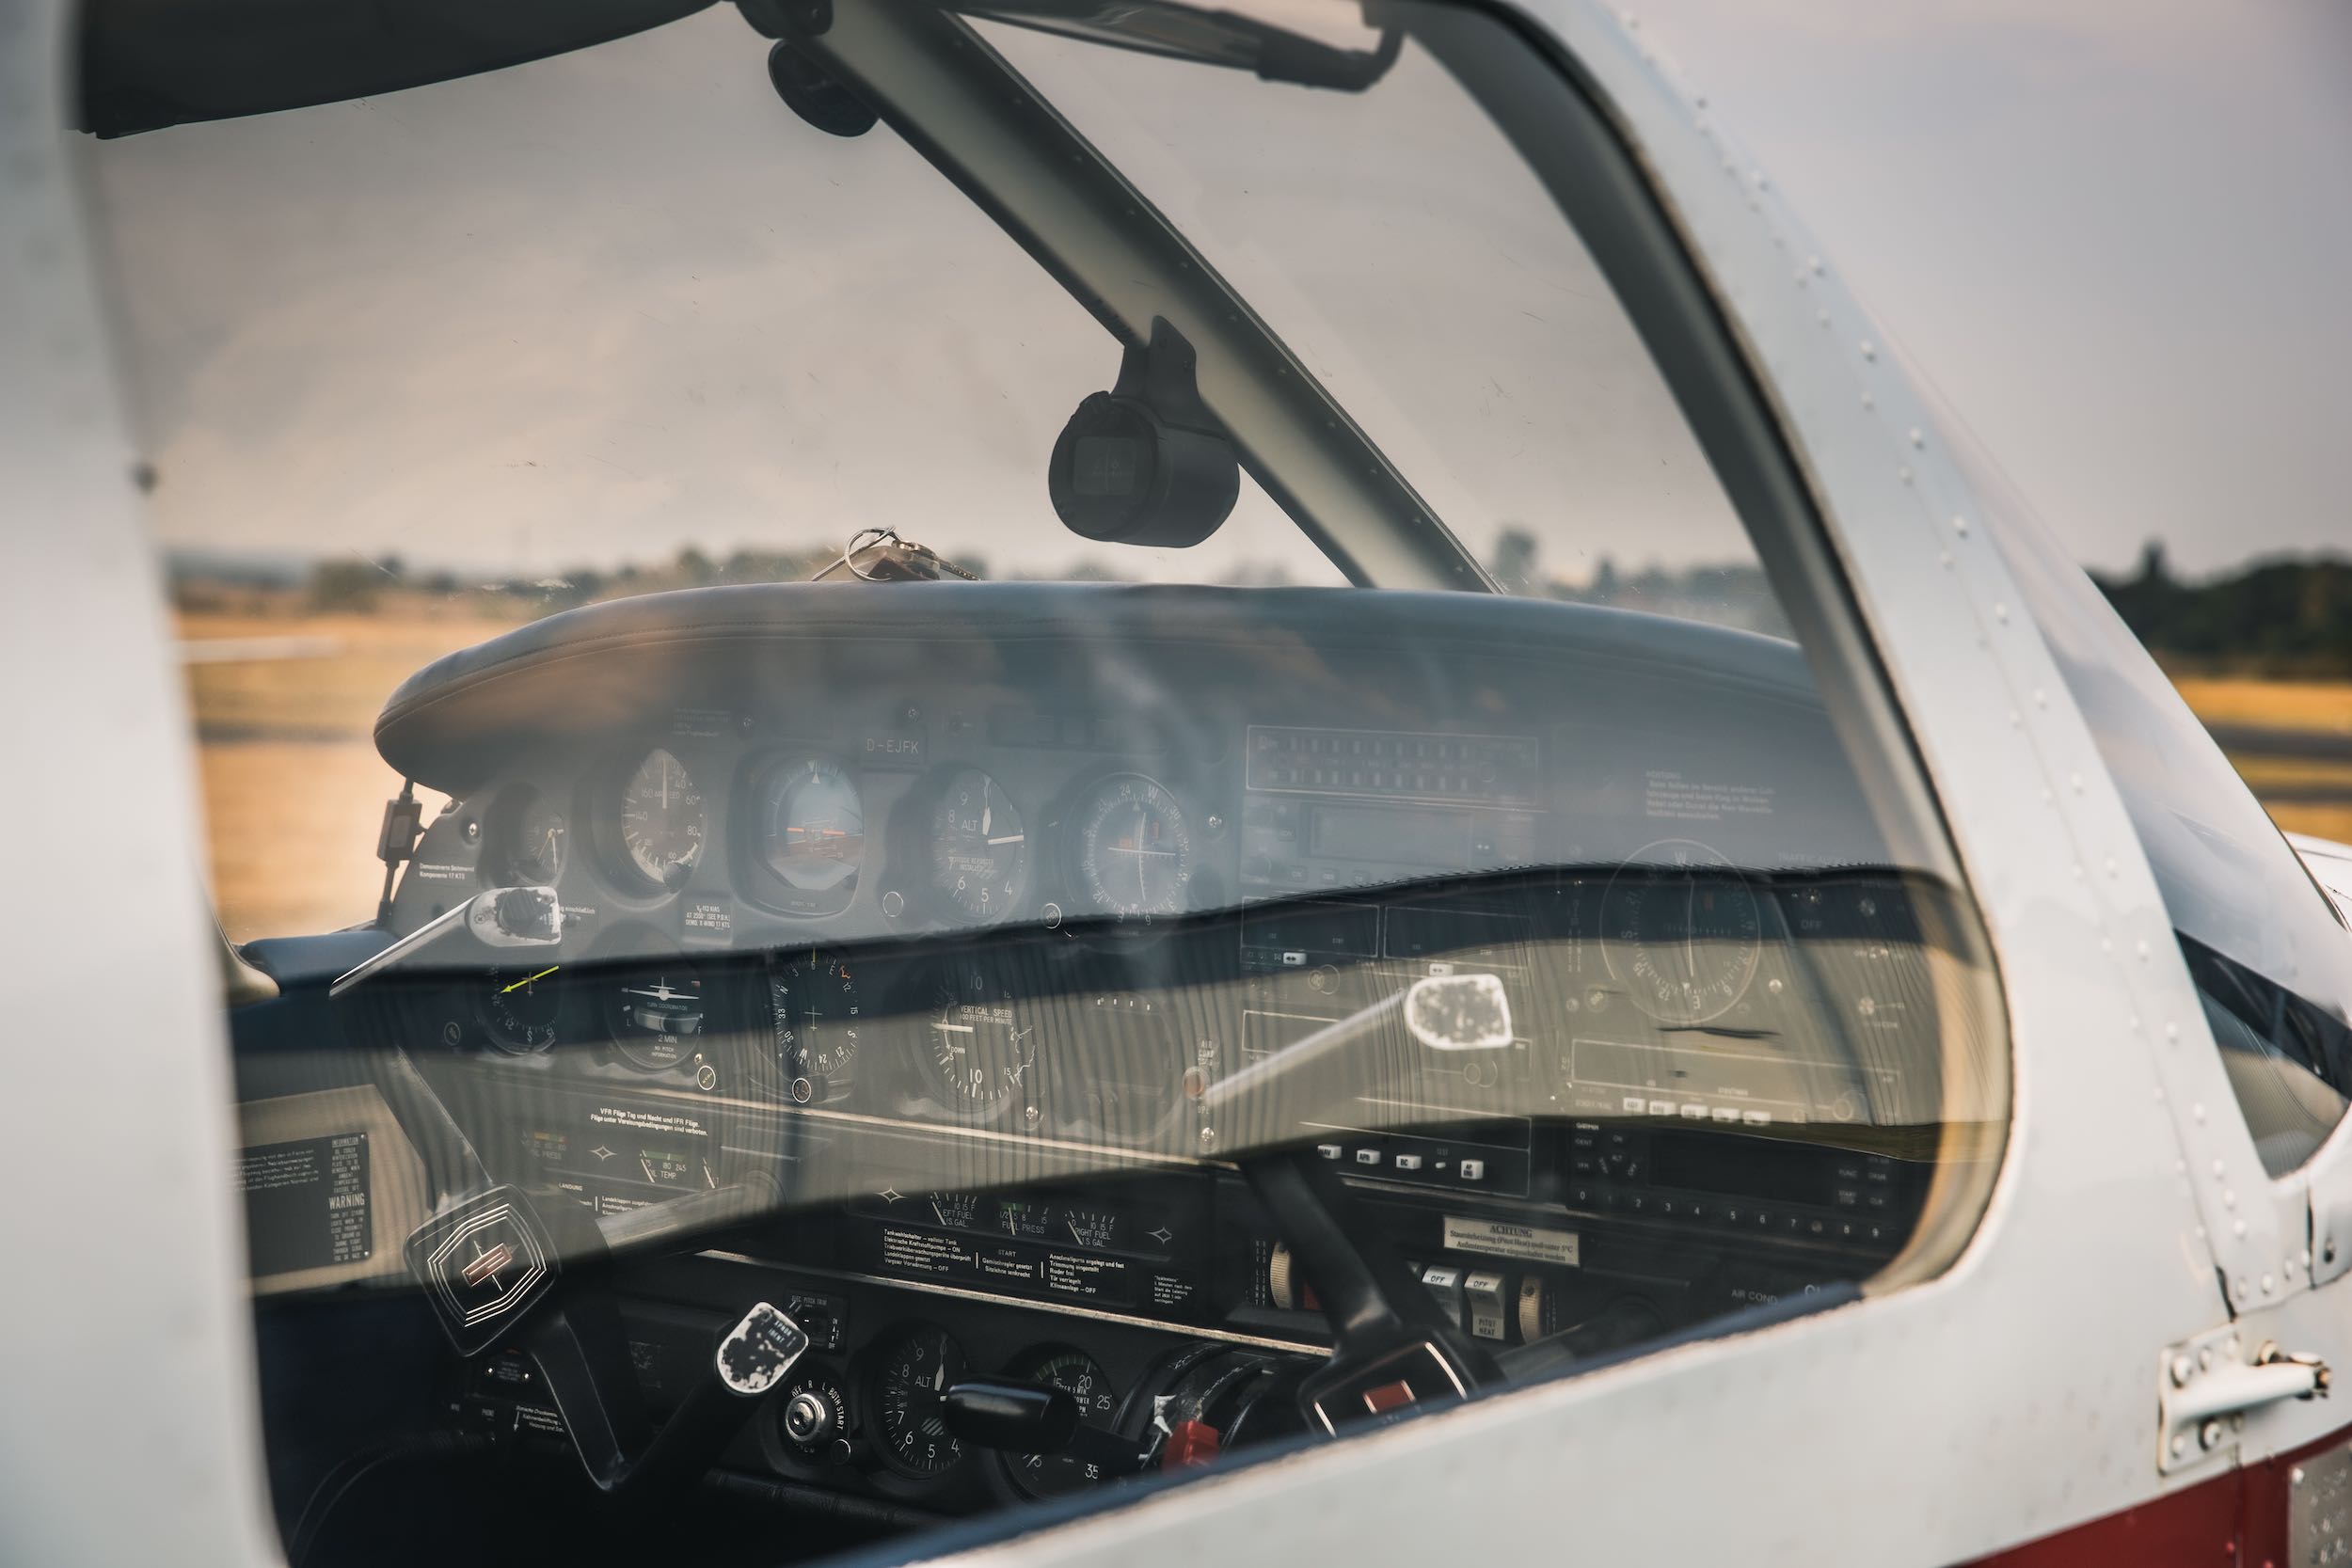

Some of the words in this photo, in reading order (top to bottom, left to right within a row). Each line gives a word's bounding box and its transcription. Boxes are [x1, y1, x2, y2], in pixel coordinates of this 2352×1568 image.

[866, 737, 919, 754] D-EJFK
[1148, 785, 1159, 799] W
[686, 795, 696, 805] 60
[960, 791, 969, 806] 9
[948, 809, 955, 822] 8
[687, 826, 697, 835] 80
[961, 819, 978, 832] ALT
[1675, 851, 1686, 865] W
[958, 875, 966, 890] 6
[1004, 881, 1013, 895] 4
[981, 887, 989, 902] 5
[842, 982, 852, 993] 12
[970, 975, 983, 991] 10
[779, 985, 789, 995] N
[778, 1008, 786, 1019] 33
[850, 1006, 858, 1015] 15
[960, 1005, 989, 1016] VERTICAL
[993, 1009, 1012, 1018] SPEED
[995, 1017, 1012, 1025] MINUTE
[527, 1030, 533, 1042] S
[664, 1035, 677, 1044] MIN
[784, 1030, 794, 1043] 30
[799, 1048, 808, 1061] W
[835, 1046, 845, 1057] 21
[818, 1053, 827, 1063] 24
[969, 1068, 983, 1084] 10
[1003, 1067, 1011, 1076] 15
[675, 1163, 687, 1172] 245
[329, 1192, 365, 1210] WARNING
[1580, 1190, 1585, 1200] 0
[1635, 1198, 1641, 1208] 2
[1664, 1202, 1671, 1212] 3
[1694, 1206, 1700, 1215] 4
[1759, 1214, 1766, 1224] 6
[1790, 1218, 1796, 1227] 7
[943, 1210, 956, 1218] EFT
[957, 1211, 974, 1220] FUEL
[1041, 1216, 1048, 1224] 15
[954, 1219, 968, 1227] GAL.
[1022, 1223, 1045, 1234] PRESS
[1094, 1231, 1110, 1240] FUEL
[1490, 1225, 1533, 1238] ACHTUNG
[946, 1237, 958, 1246] Tank
[1091, 1238, 1106, 1248] GAL.
[998, 1249, 1017, 1257] START
[1430, 1275, 1445, 1283] OFF
[1731, 1289, 1745, 1299] AIR
[1478, 1319, 1496, 1328] PITOT
[916, 1347, 924, 1361] 9
[902, 1363, 910, 1377] 8
[808, 1380, 813, 1388] R
[822, 1382, 826, 1392] L
[914, 1376, 932, 1388] ALT
[1053, 1377, 1062, 1387] 15
[1077, 1374, 1093, 1390] 20
[828, 1387, 842, 1406] BOTH
[1097, 1395, 1111, 1410] 25
[836, 1406, 844, 1430] START
[897, 1410, 905, 1425] 7
[905, 1430, 914, 1445] 6
[927, 1444, 936, 1459] 5
[951, 1438, 959, 1453] 4
[1085, 1463, 1098, 1479] 35
